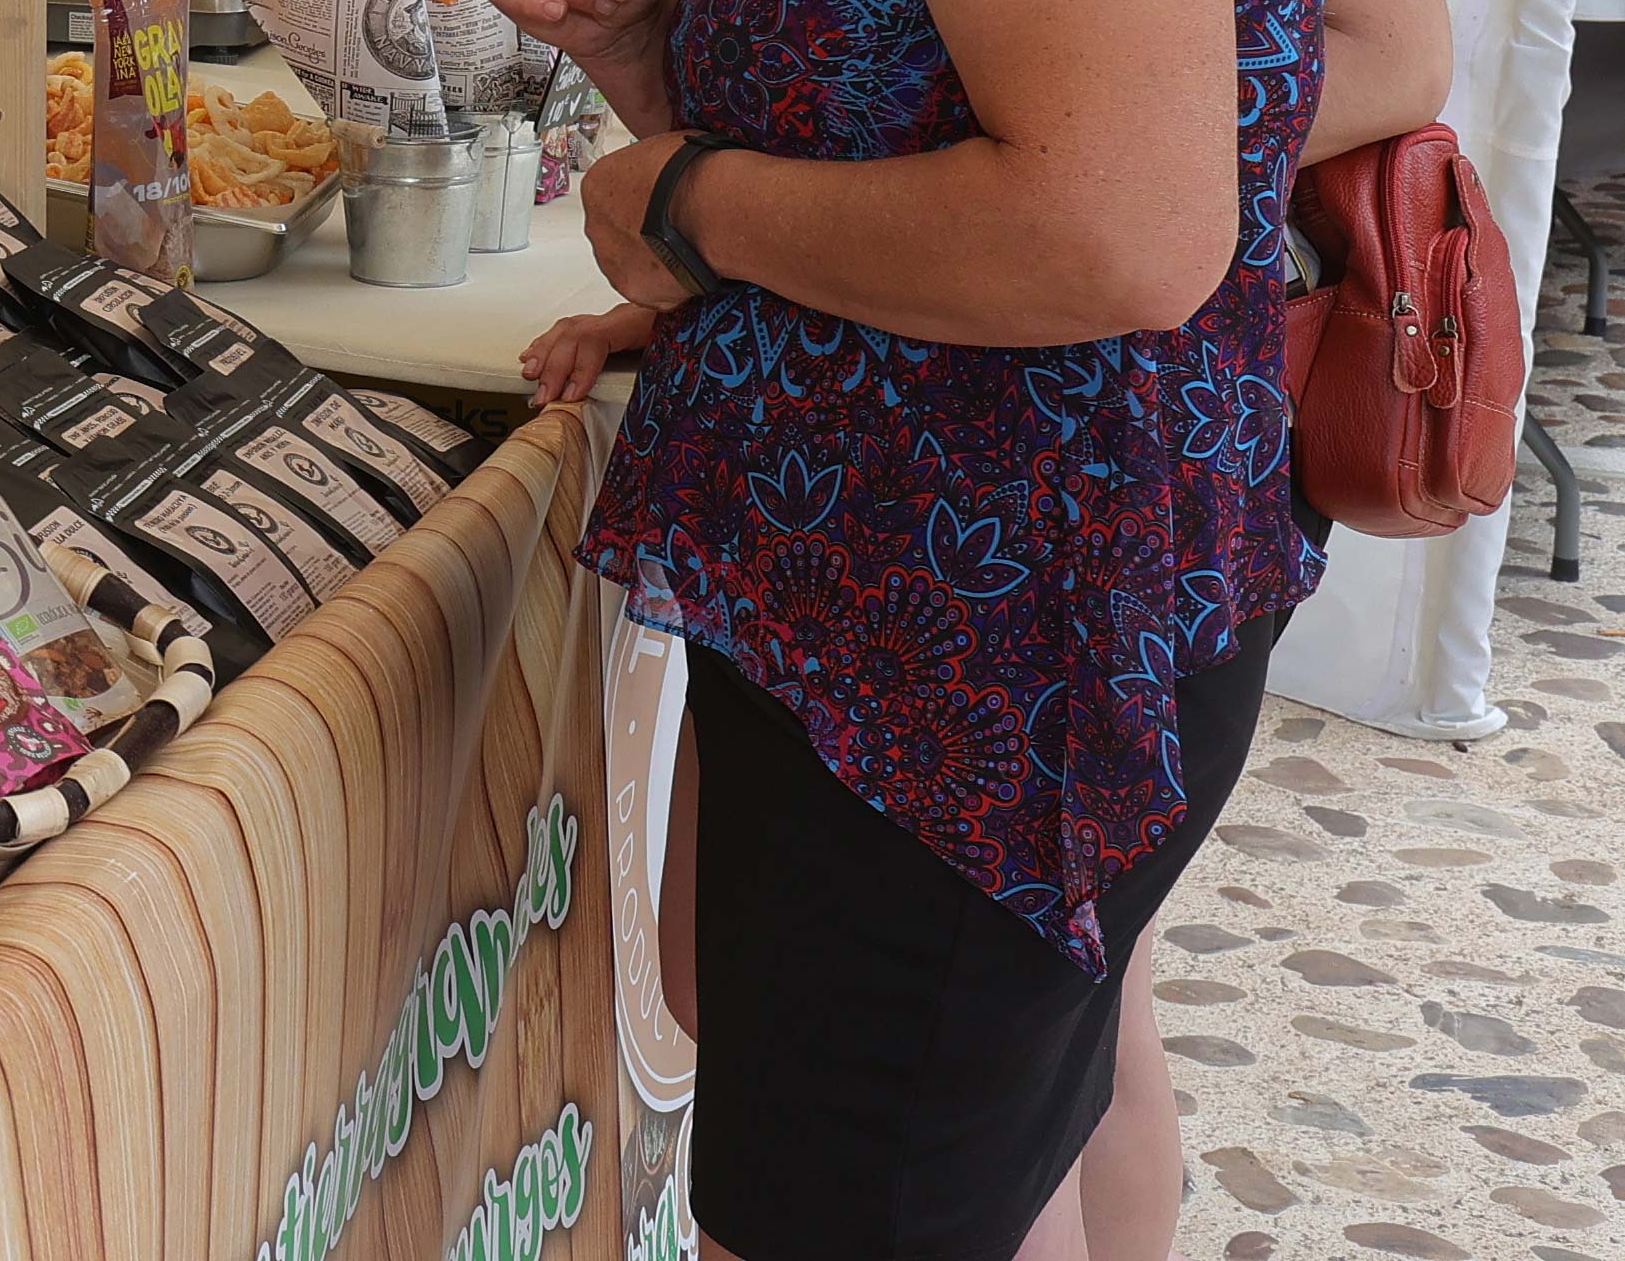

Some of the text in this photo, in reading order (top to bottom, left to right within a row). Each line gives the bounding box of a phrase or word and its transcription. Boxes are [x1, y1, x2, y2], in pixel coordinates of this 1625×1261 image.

[113, 45, 133, 58] NEW
[375, 35, 425, 72] NAVY
[112, 57, 135, 71] YORK
[116, 68, 137, 80] INA
[144, 67, 184, 117] OLA
